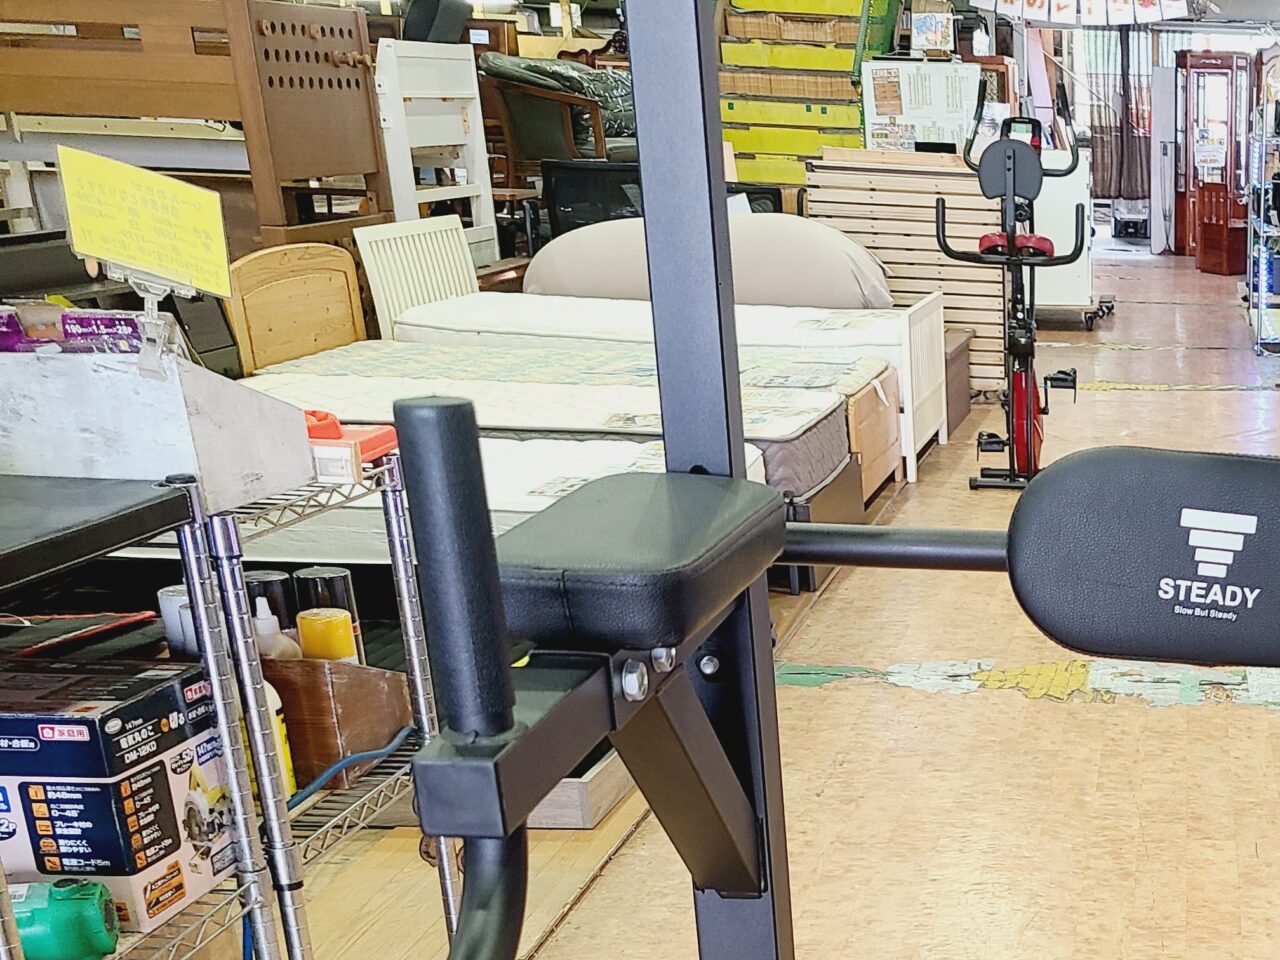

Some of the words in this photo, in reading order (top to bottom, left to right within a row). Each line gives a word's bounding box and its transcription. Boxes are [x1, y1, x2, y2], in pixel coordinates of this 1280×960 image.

[1158, 577, 1261, 608] STEADY
[1174, 605, 1194, 616] Slow
[1194, 608, 1209, 619] But
[1209, 610, 1238, 622] Steady
[57, 729, 86, 738] 家庭用
